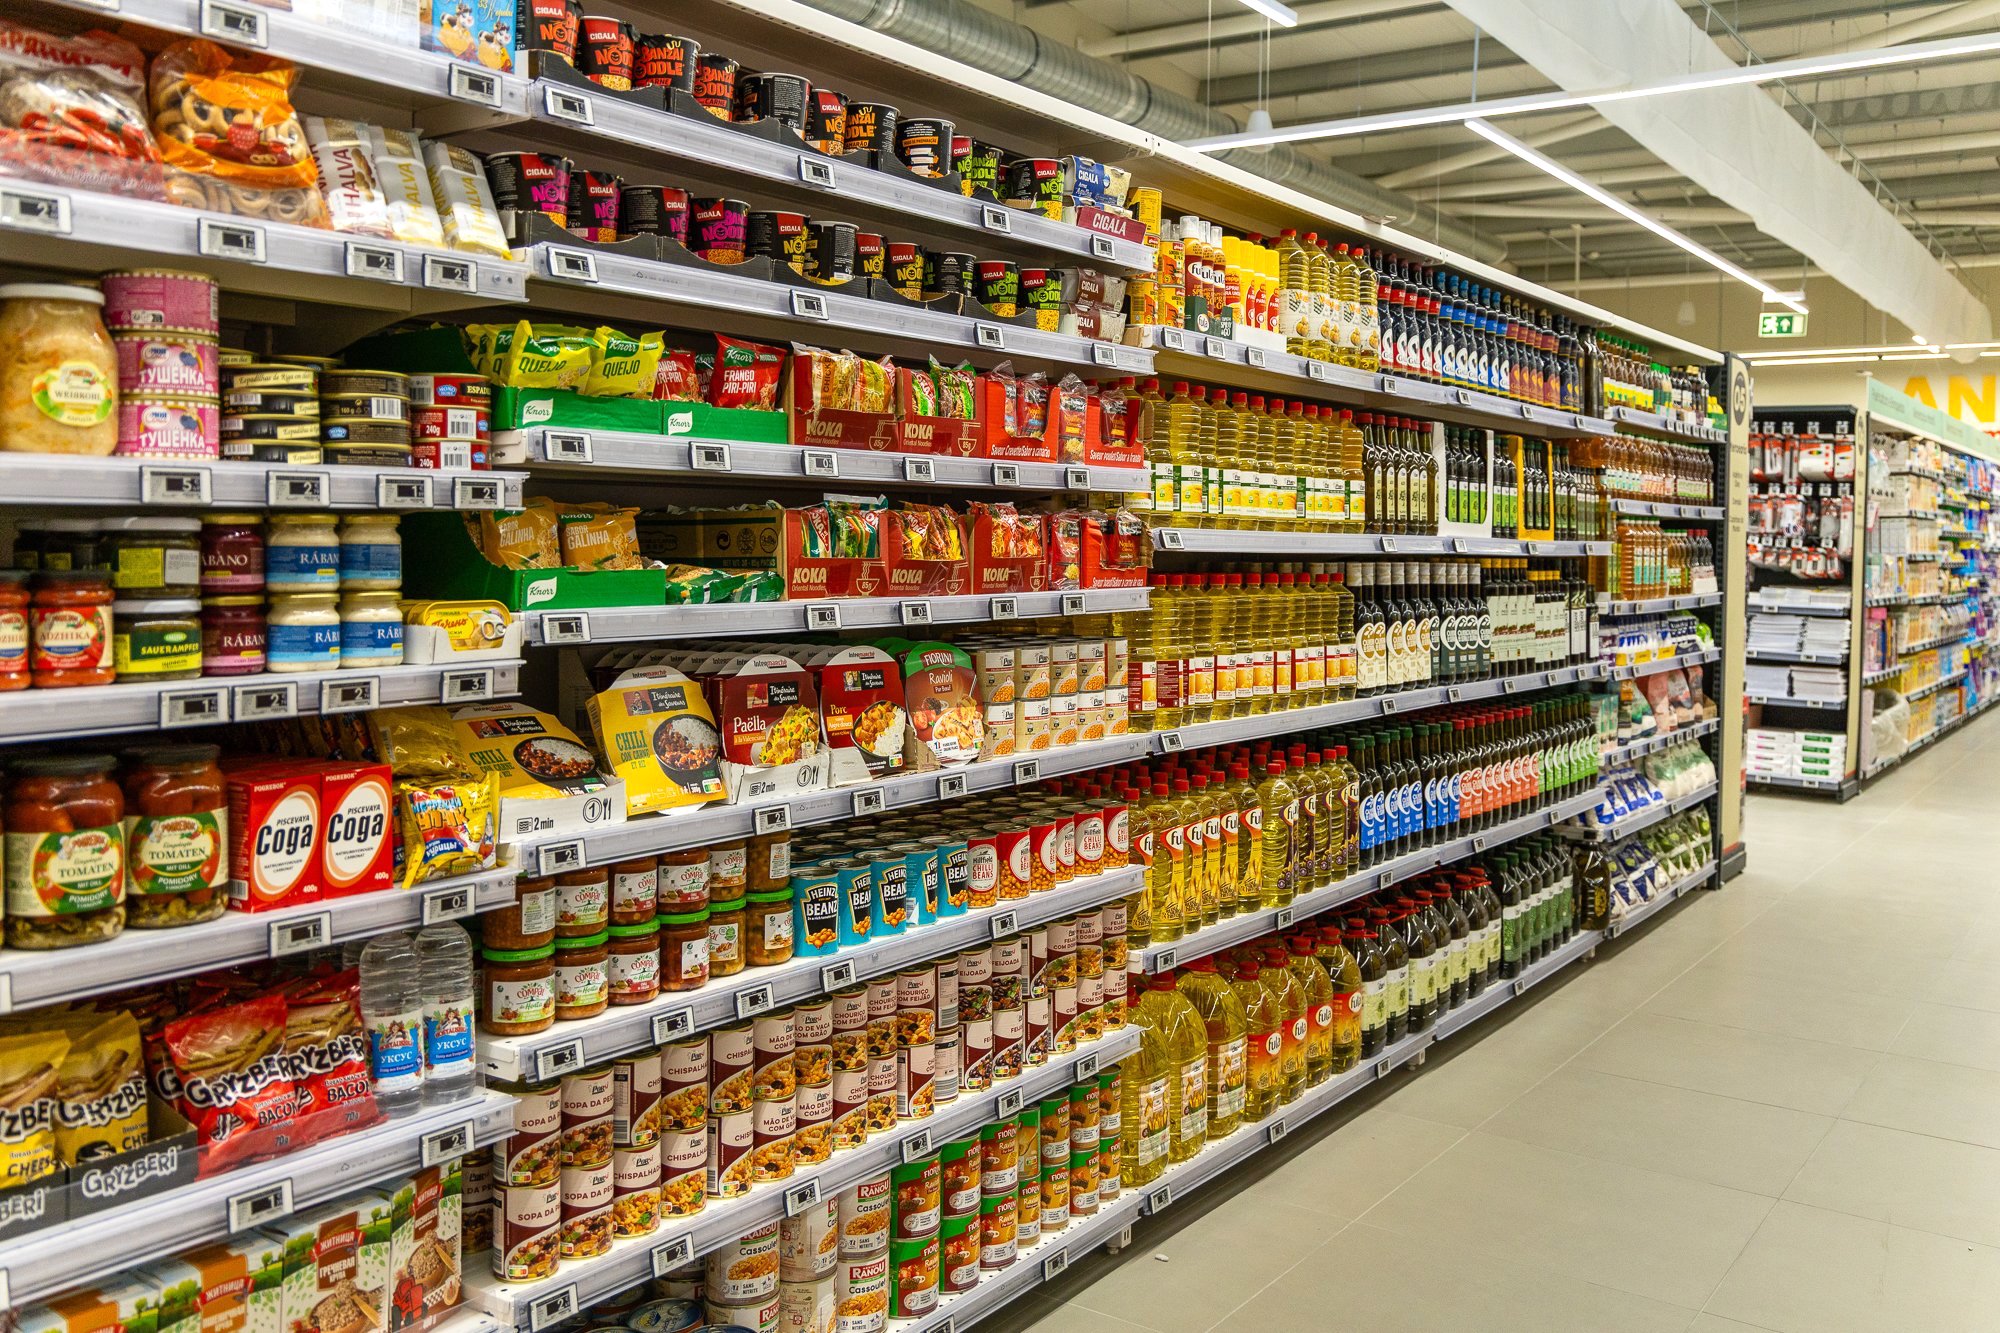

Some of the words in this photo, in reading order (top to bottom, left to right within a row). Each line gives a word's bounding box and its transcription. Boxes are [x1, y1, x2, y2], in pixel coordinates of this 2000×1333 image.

[535, 6, 563, 17] CIGALA
[589, 31, 616, 42] CIGALA
[821, 103, 841, 113] CIGALA
[526, 168, 554, 177] CIGALA
[1037, 170, 1056, 178] CIGALA
[1078, 170, 1098, 185] CIGALA
[590, 186, 613, 195] CIGALA
[697, 210, 722, 219] CIGALA
[780, 224, 801, 232] CIGALA
[1092, 213, 1127, 237] CIGALA
[892, 254, 914, 263] CIGALA
[983, 271, 1004, 279] CIGALA
[1023, 279, 1044, 287] CIGALA
[1080, 281, 1099, 294] CIGALA
[608, 338, 637, 353] Knorr
[725, 349, 753, 363] Knorr
[519, 357, 567, 373] QUEIJO
[603, 360, 640, 377] QUEIJO
[724, 370, 754, 382] FRANGO
[823, 356, 832, 393] CHICKE
[722, 382, 757, 394] PIRI-PIRI
[1733, 386, 1746, 413] 05
[525, 404, 551, 418] Knorr
[669, 418, 692, 429] Knorr
[904, 423, 933, 439] KOKA
[566, 525, 588, 537] SABOR
[500, 529, 534, 547] GALINHA
[567, 529, 610, 550] GALINHA
[793, 567, 827, 584] KOKA
[892, 569, 921, 584] KOKA
[983, 567, 1009, 582] KOKA
[529, 586, 554, 598] Knorr
[224, 633, 264, 647] RÁBAN
[924, 653, 954, 667] FIORINI
[929, 671, 953, 684] Ravioli
[831, 704, 847, 714] Porc
[733, 718, 766, 732] Paëlla
[616, 731, 646, 750] CHILI
[470, 750, 505, 765] CHILI
[348, 804, 381, 816] PISCEVAYA
[276, 814, 310, 826] PISCEVAYA
[534, 818, 541, 830] 2
[541, 817, 554, 828] min
[327, 813, 384, 845] Coga
[256, 824, 313, 857] Coga
[1083, 834, 1102, 843] CHILLI
[1083, 842, 1102, 850] BEANS
[149, 848, 206, 861] TOMATEN
[58, 863, 117, 879] TOMATEN
[973, 864, 994, 873] CHILLI
[157, 873, 198, 886] POMIDORY
[374, 872, 389, 882] 400g
[972, 871, 993, 880] BEANS
[809, 884, 838, 900] HEINZ
[806, 900, 838, 916] BEANZ
[834, 1011, 866, 1021] CHOURIÇO
[437, 1038, 467, 1050] УКСУС
[380, 1051, 412, 1064] УКСУС
[668, 1062, 707, 1076] CHISPALHA
[564, 1101, 588, 1110] SOPA
[590, 1099, 599, 1108] DA
[856, 1200, 889, 1213] Cassoulet
[518, 1212, 541, 1222] SOPA
[542, 1208, 552, 1217] DA
[320, 1232, 355, 1251] ЖИТНИЦА
[851, 1264, 887, 1280] RANOU
[206, 1280, 244, 1301] ЖИТНИЦА
[848, 1282, 888, 1297] Cassoulet
